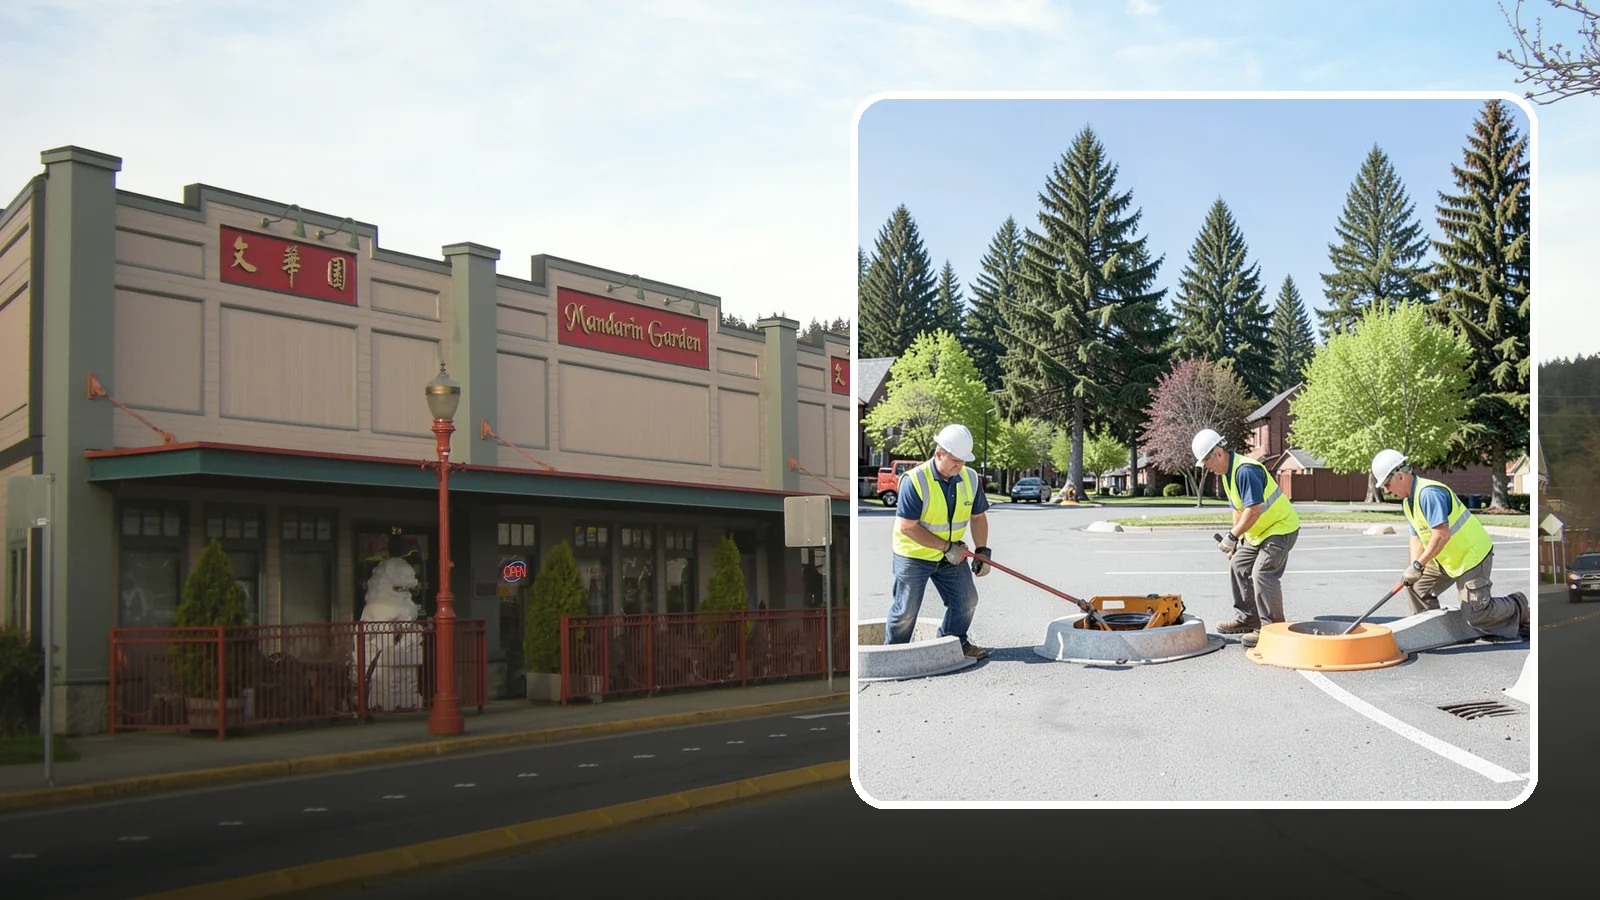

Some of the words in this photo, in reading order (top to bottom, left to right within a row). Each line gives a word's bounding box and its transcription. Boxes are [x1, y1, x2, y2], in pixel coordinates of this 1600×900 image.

[231, 236, 346, 291] 文華園
[564, 302, 644, 341] Mandarin
[647, 320, 702, 352] Garden
[834, 362, 847, 386] 文
[503, 565, 527, 578] OPEN
